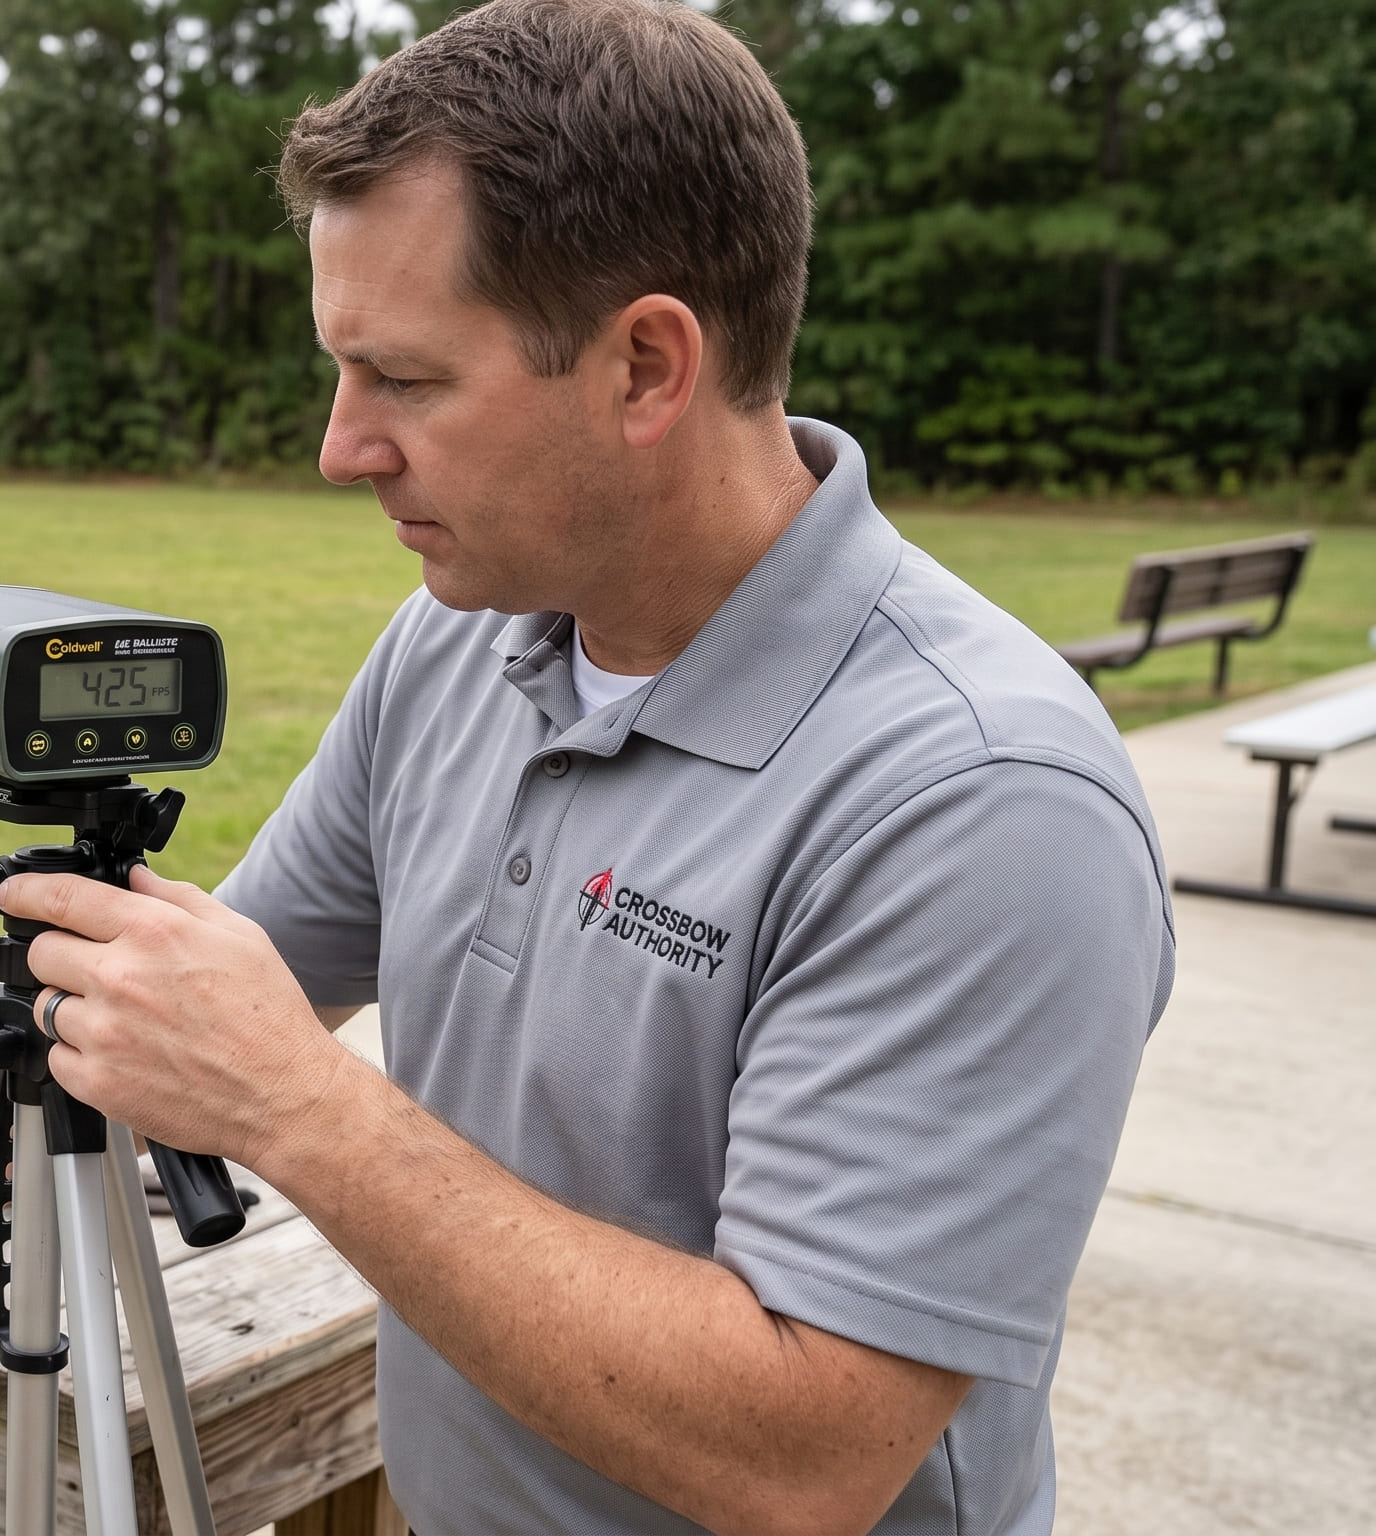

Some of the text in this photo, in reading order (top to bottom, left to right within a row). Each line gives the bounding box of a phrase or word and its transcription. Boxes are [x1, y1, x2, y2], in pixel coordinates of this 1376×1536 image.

[45, 638, 102, 659] Coldwell
[82, 666, 170, 708] 425 FPS
[602, 913, 724, 979] AUTHORITY
[614, 887, 732, 953] CROSSBOW
